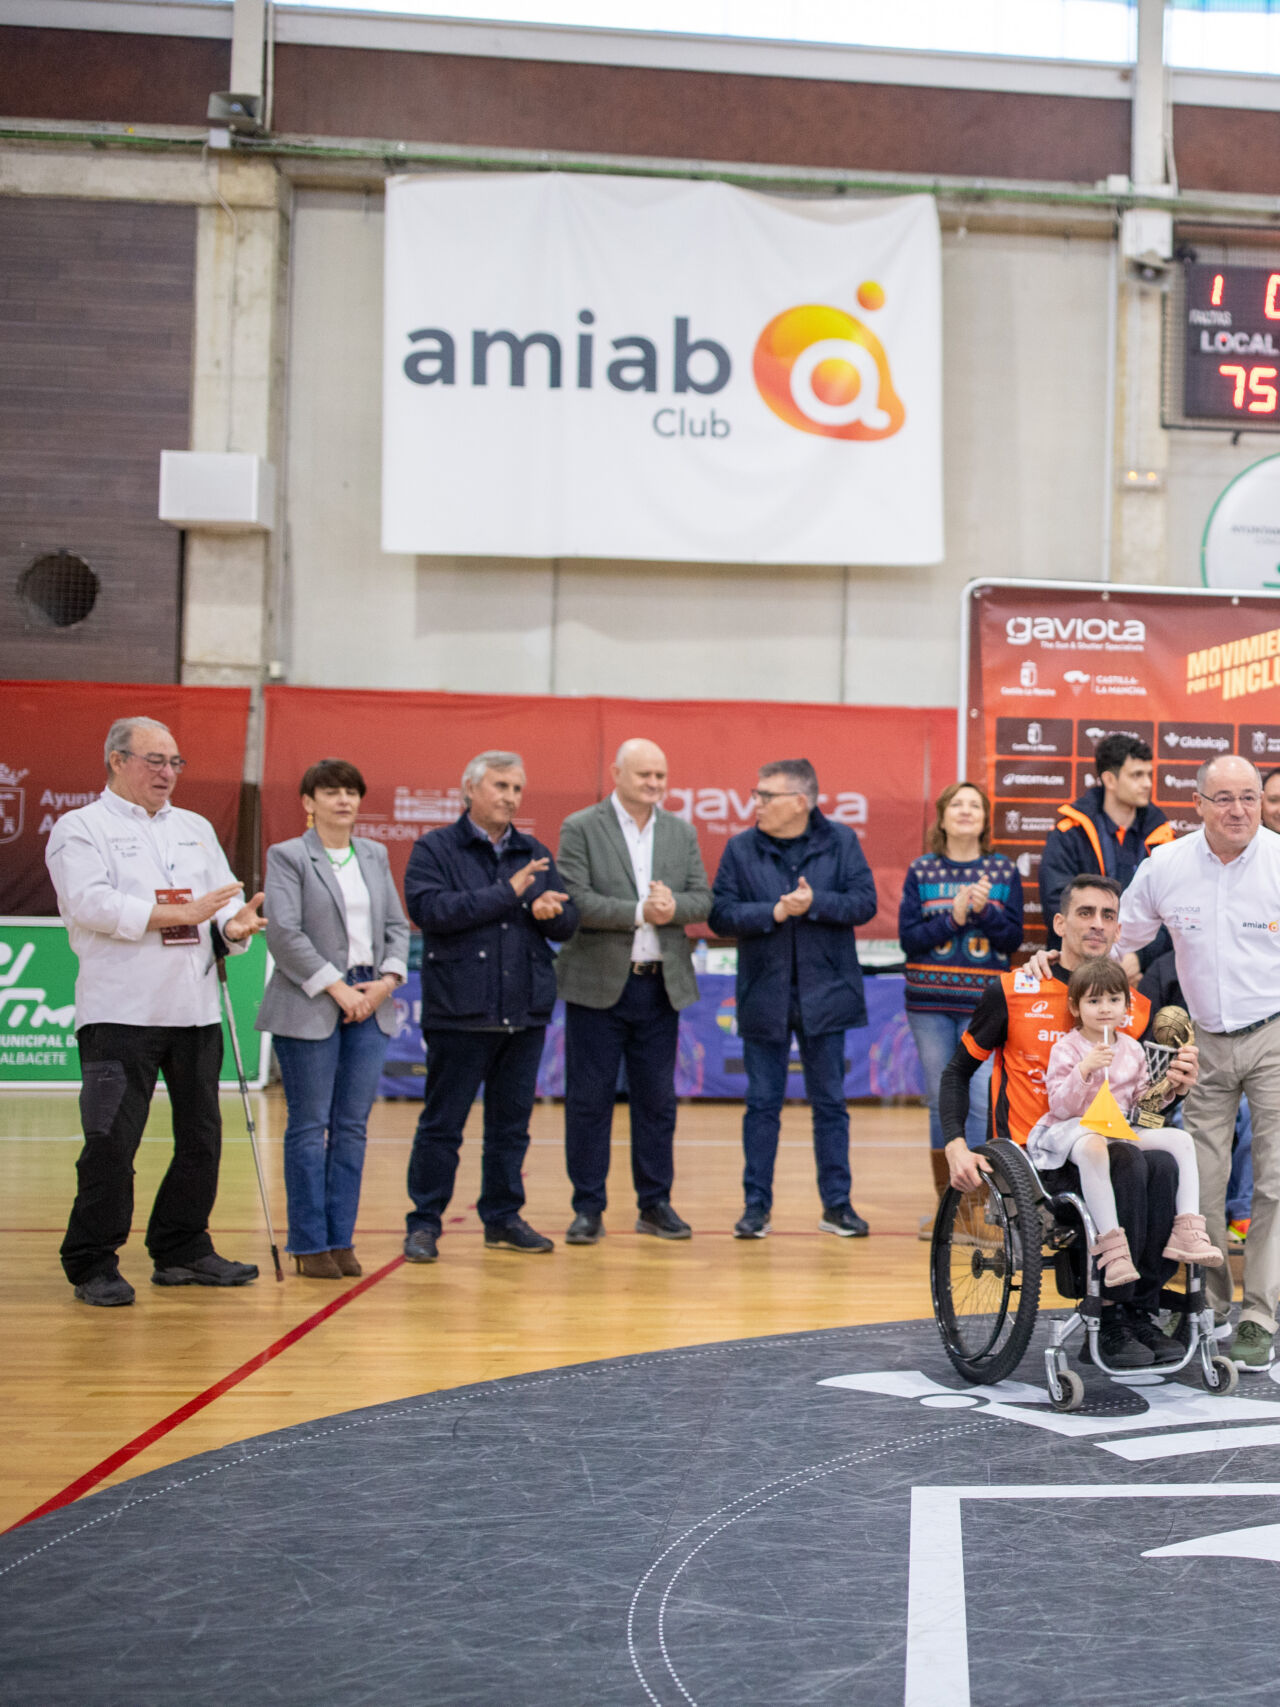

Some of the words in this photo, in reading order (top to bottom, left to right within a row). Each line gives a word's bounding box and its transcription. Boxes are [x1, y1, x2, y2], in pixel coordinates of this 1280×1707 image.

[403, 308, 733, 396] amiab
[1201, 329, 1280, 357] LOCAL
[1219, 364, 1278, 413] 75
[652, 408, 731, 439] Club
[1005, 616, 1146, 646] gaviota
[1208, 672, 1221, 689] LA
[1243, 921, 1268, 929] amiab
[0, 1034, 64, 1048] UNICIPAL
